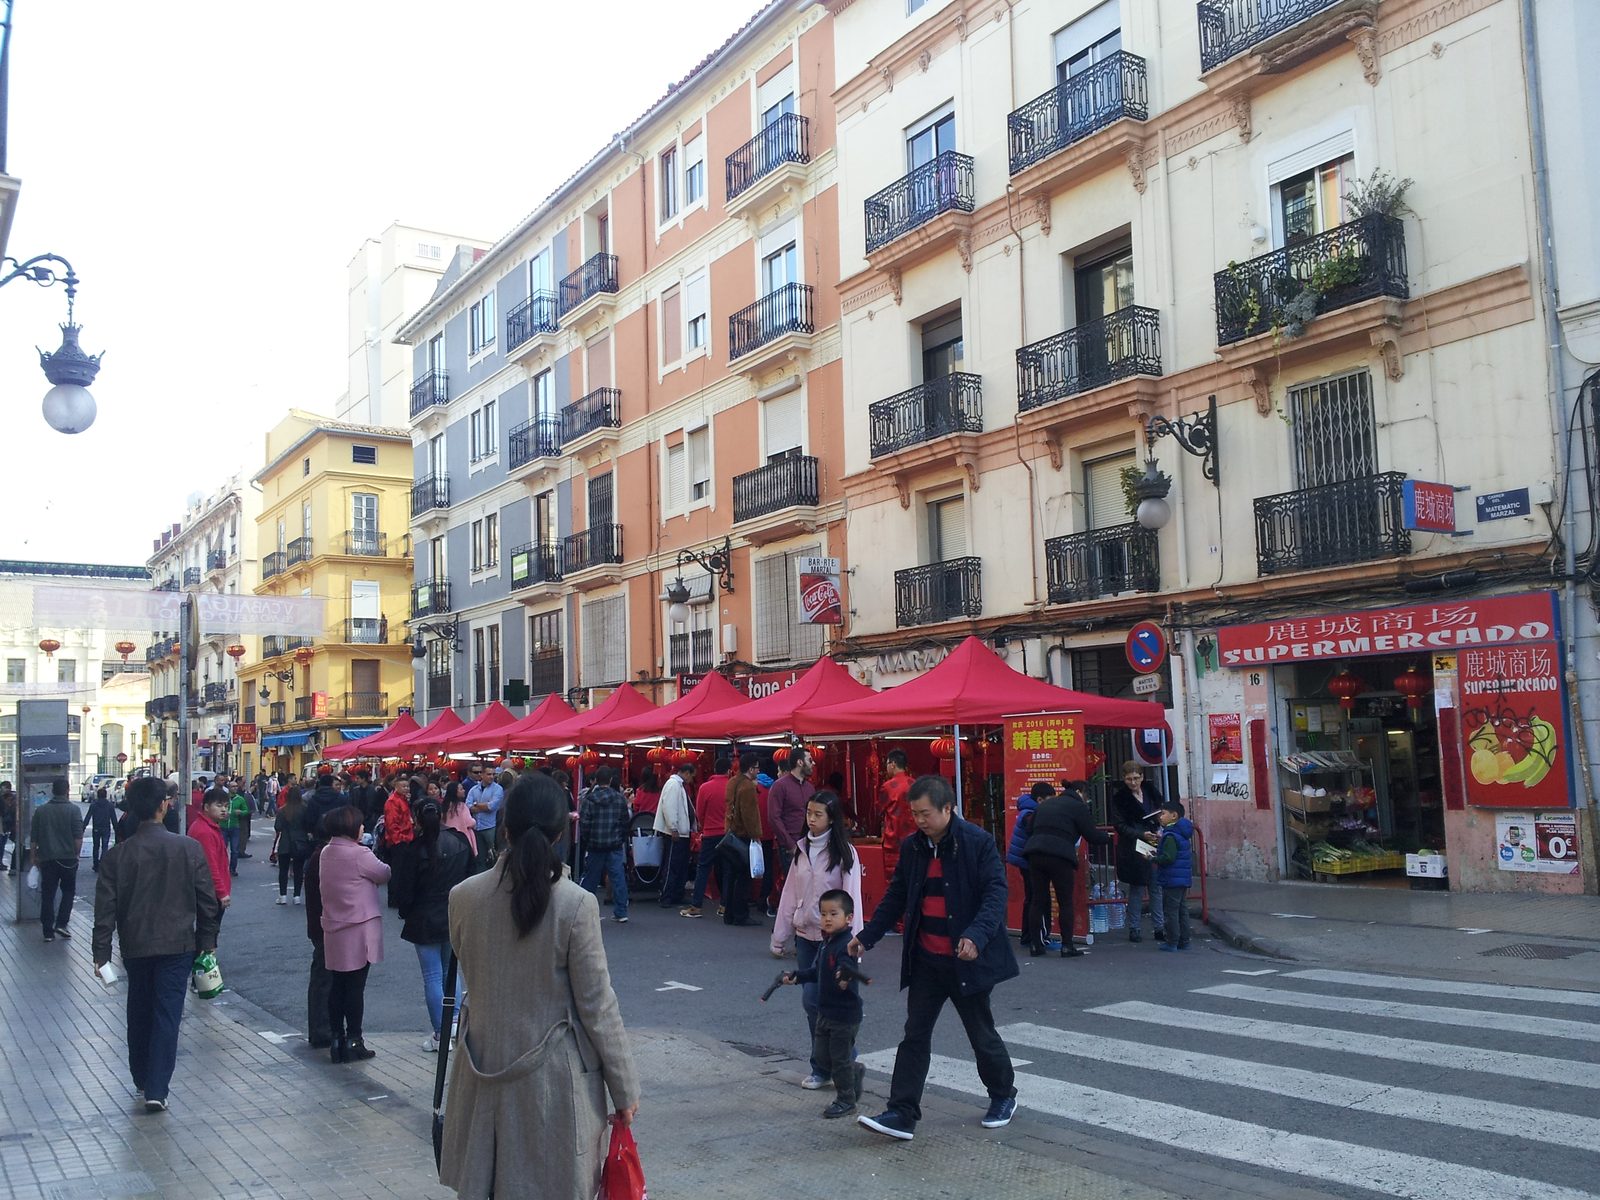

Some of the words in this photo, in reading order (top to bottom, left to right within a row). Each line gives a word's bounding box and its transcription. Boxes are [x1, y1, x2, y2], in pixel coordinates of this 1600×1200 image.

[1414, 488, 1454, 525] 鹿城商场
[1490, 510, 1516, 518] MARZAL
[1265, 606, 1477, 642] 鹿城商场
[1223, 621, 1550, 664] SUPERMERCADO
[1465, 648, 1552, 678] 鹿城商场
[748, 677, 780, 698] fone
[1250, 673, 1260, 686] 16
[1464, 676, 1557, 695] SUPERMERCADO
[1026, 720, 1044, 728] 2016
[1012, 728, 1075, 750] 新春佳节
